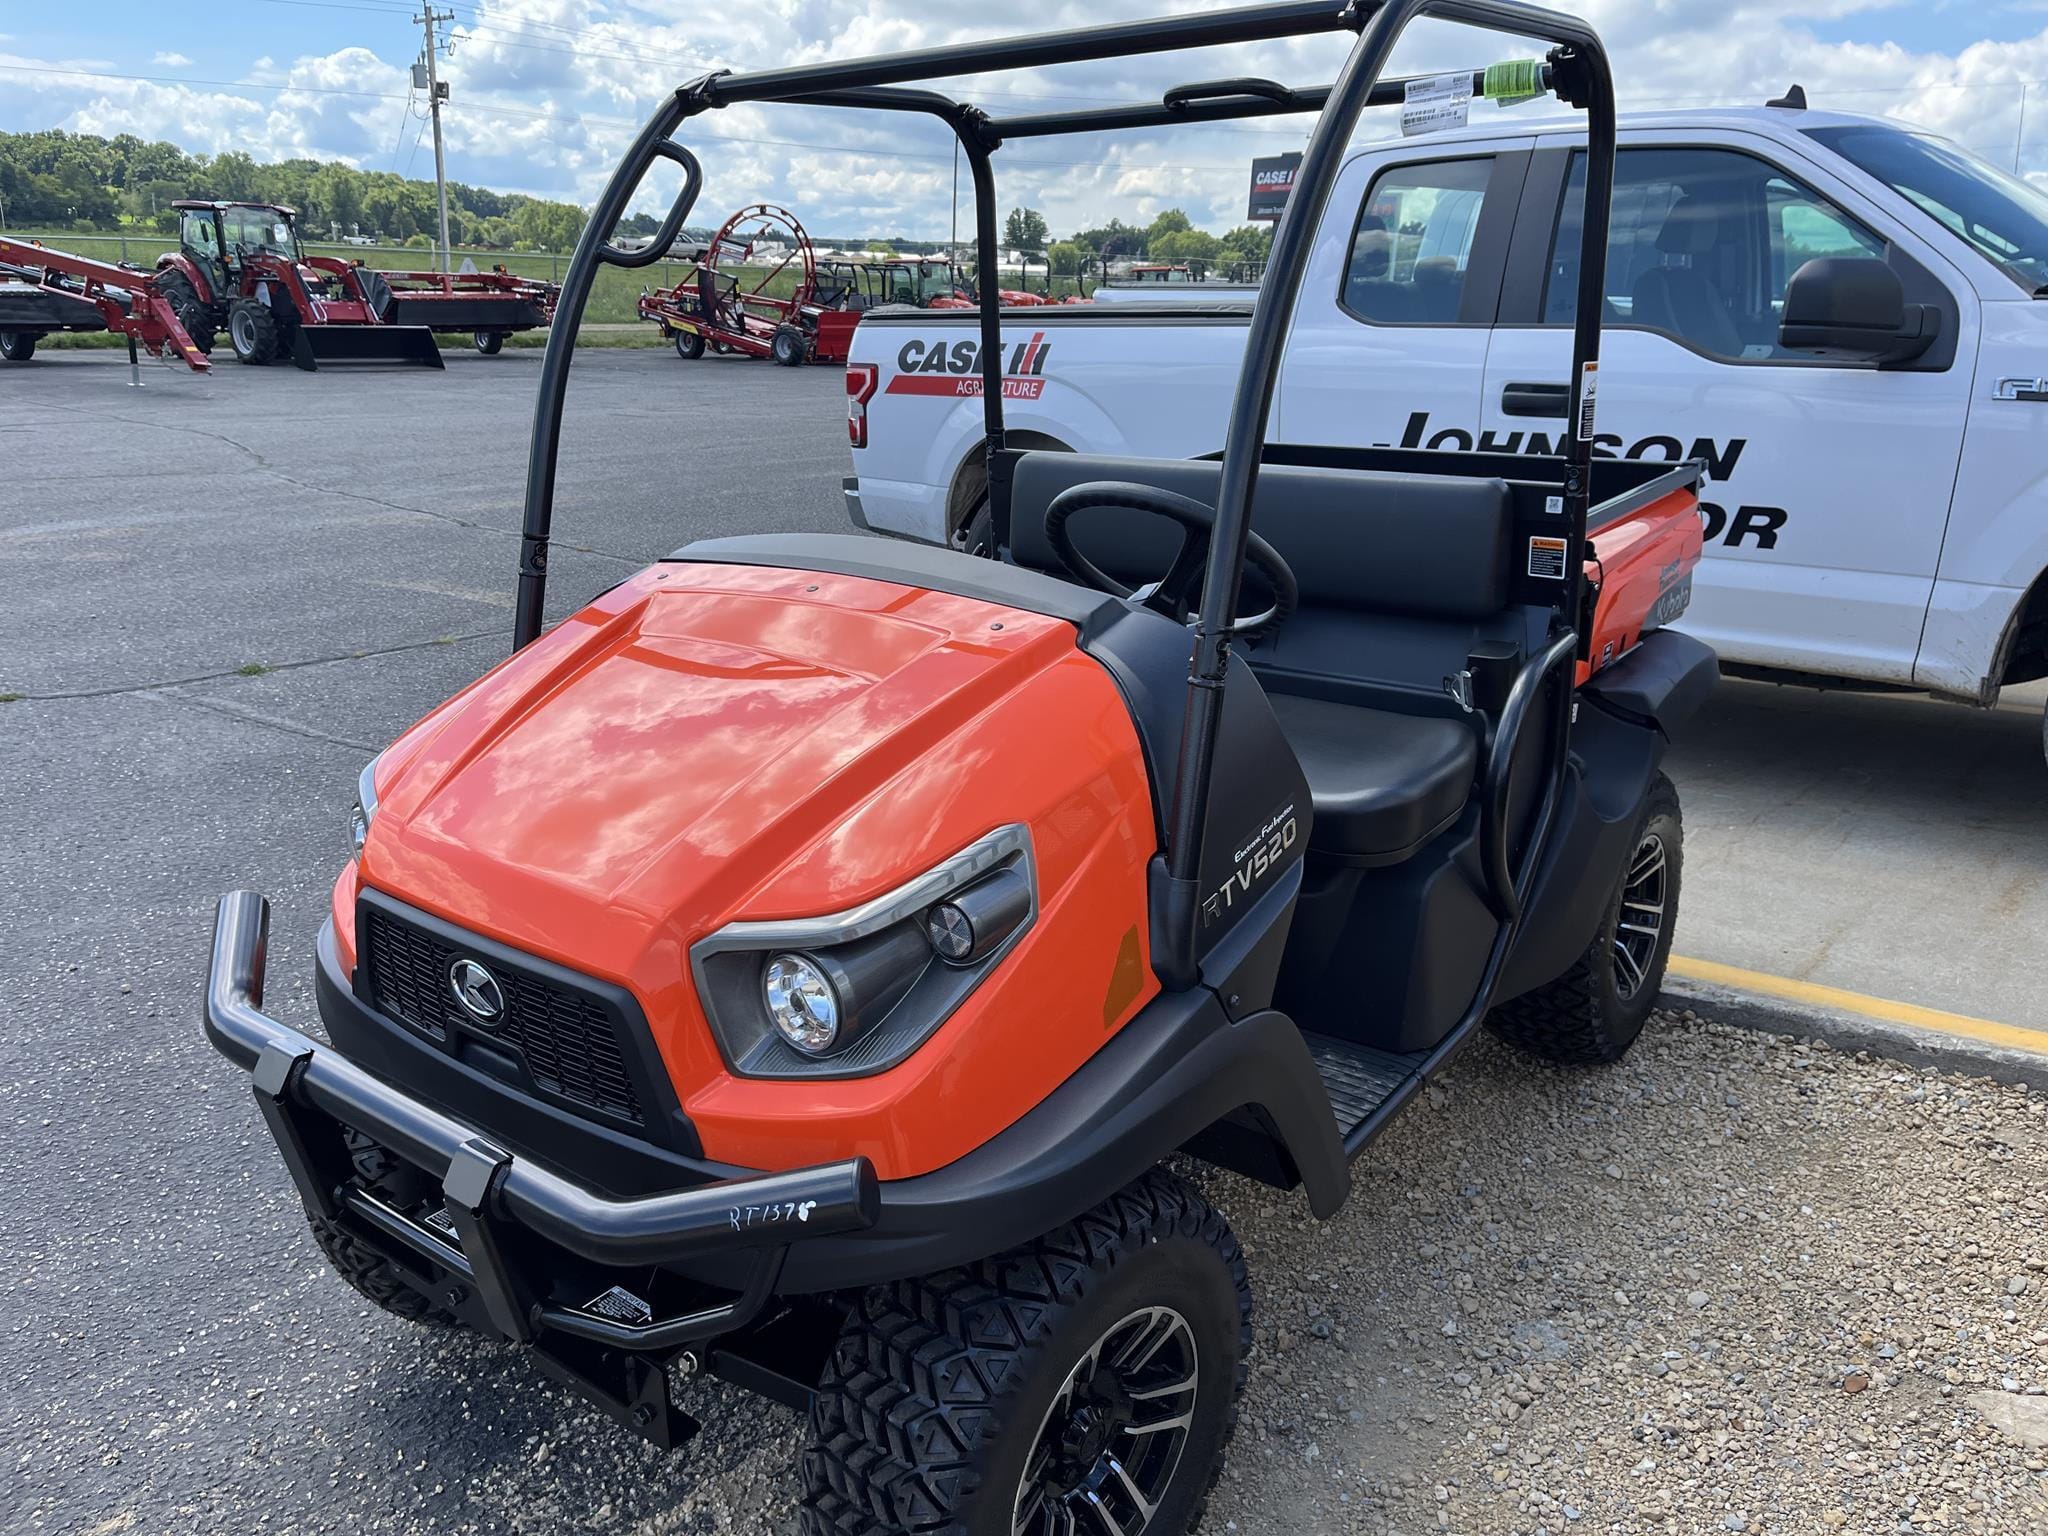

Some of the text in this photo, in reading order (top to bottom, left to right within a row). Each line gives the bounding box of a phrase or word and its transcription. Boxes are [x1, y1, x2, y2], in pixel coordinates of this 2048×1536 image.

[1256, 171, 1287, 185] CASE
[956, 380, 1038, 397] AGRILTURE
[1234, 804, 1294, 863] Electronic Fuel Injection
[1202, 817, 1297, 928] RTV520
